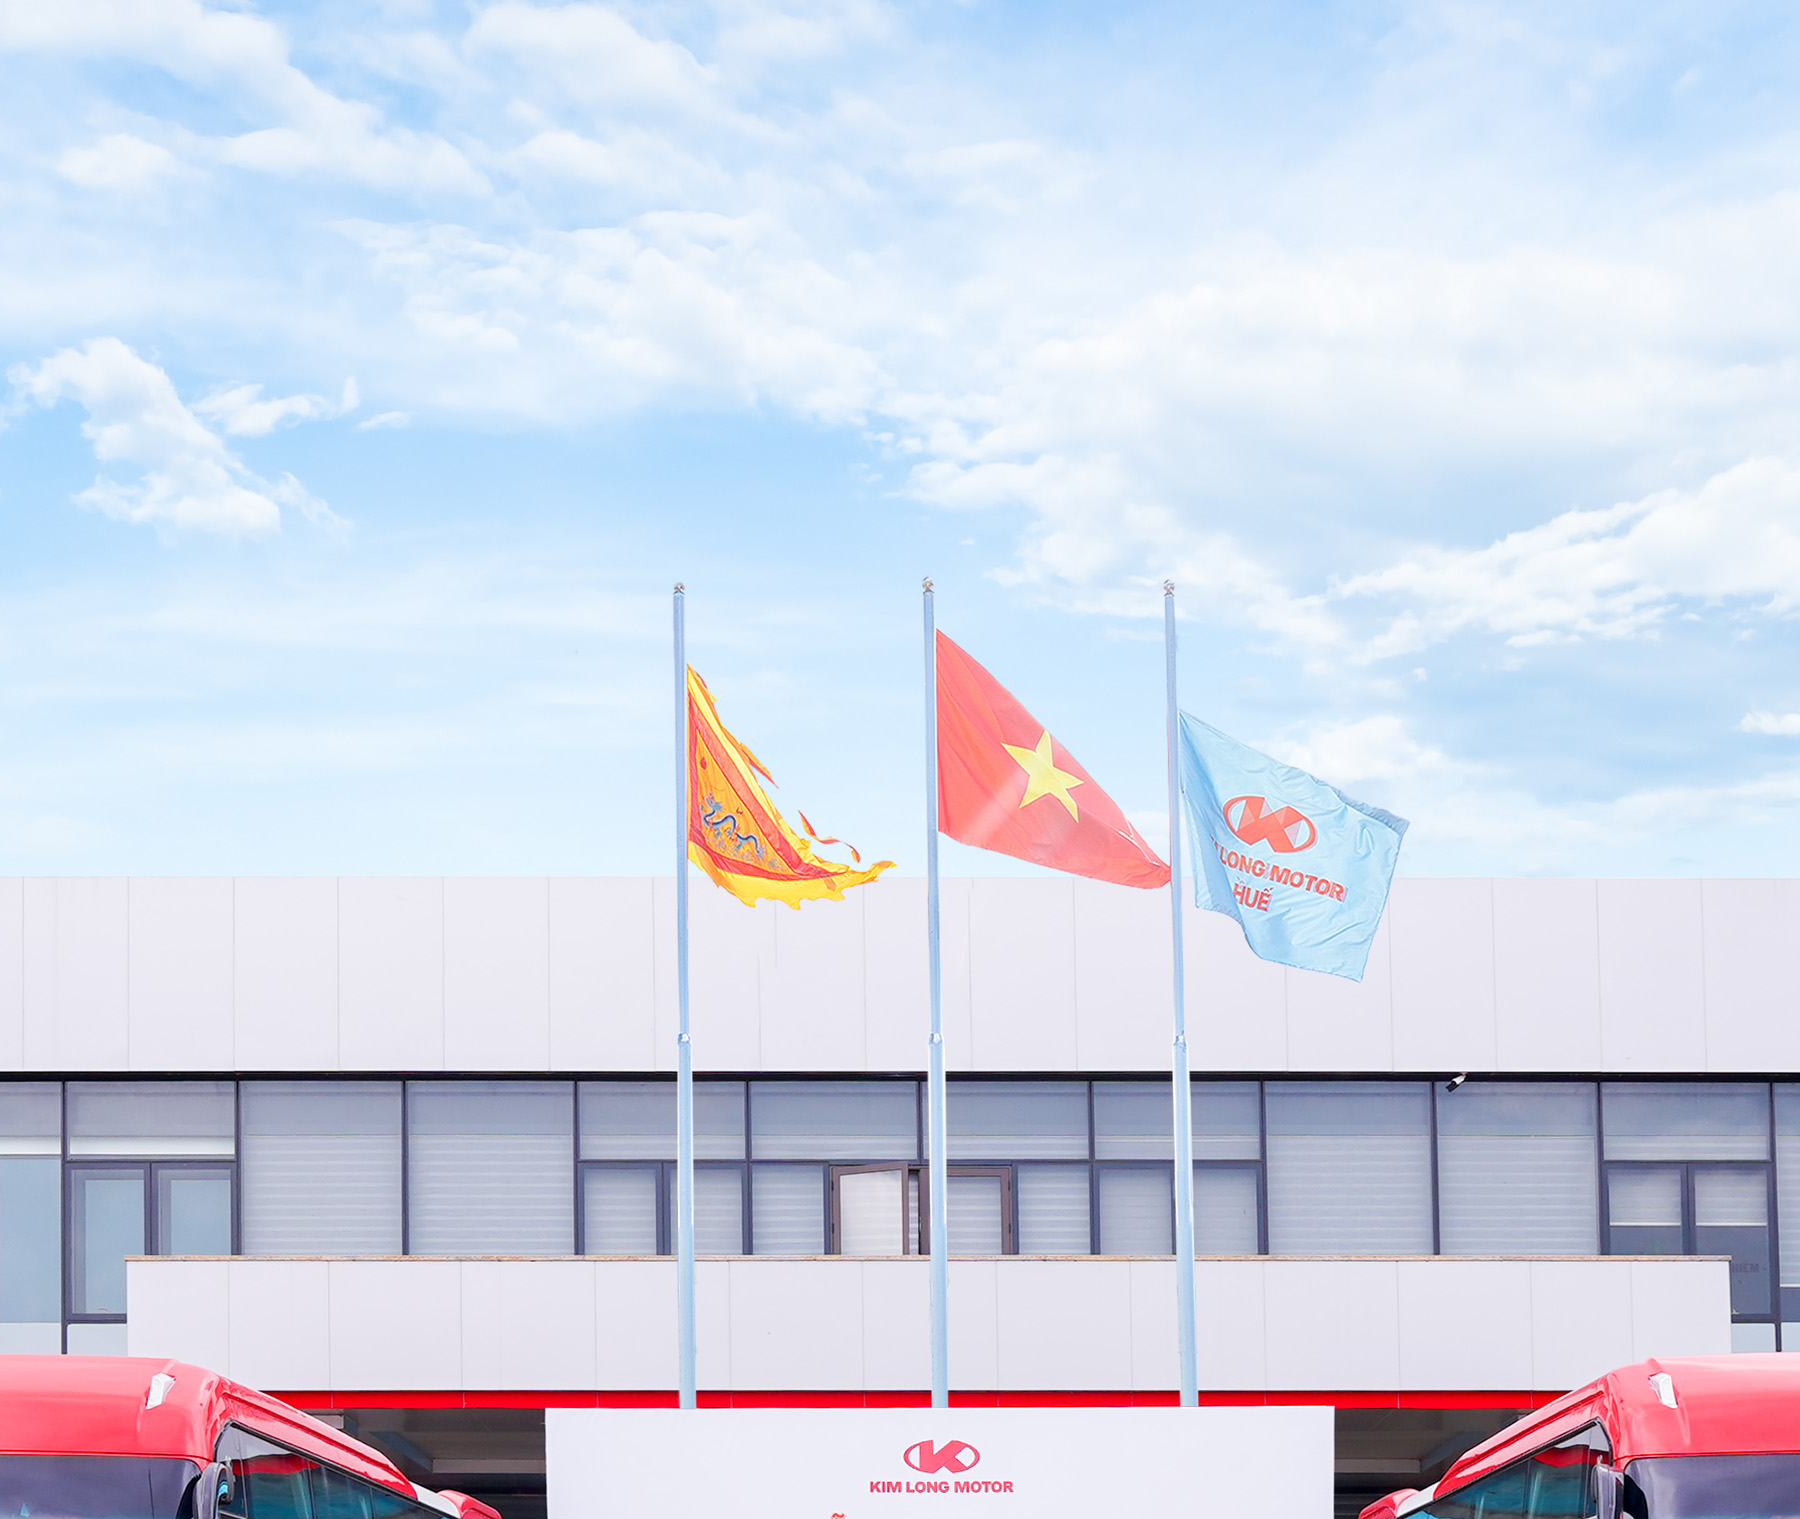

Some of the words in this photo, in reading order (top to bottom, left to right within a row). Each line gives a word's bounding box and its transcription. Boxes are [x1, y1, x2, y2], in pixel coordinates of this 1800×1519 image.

[1233, 881, 1274, 912] HUẾ
[1269, 865, 1347, 902] MOTOR
[869, 1481, 902, 1493] KIM
[906, 1481, 950, 1493] LONG
[954, 1481, 1014, 1493] MOTOR
